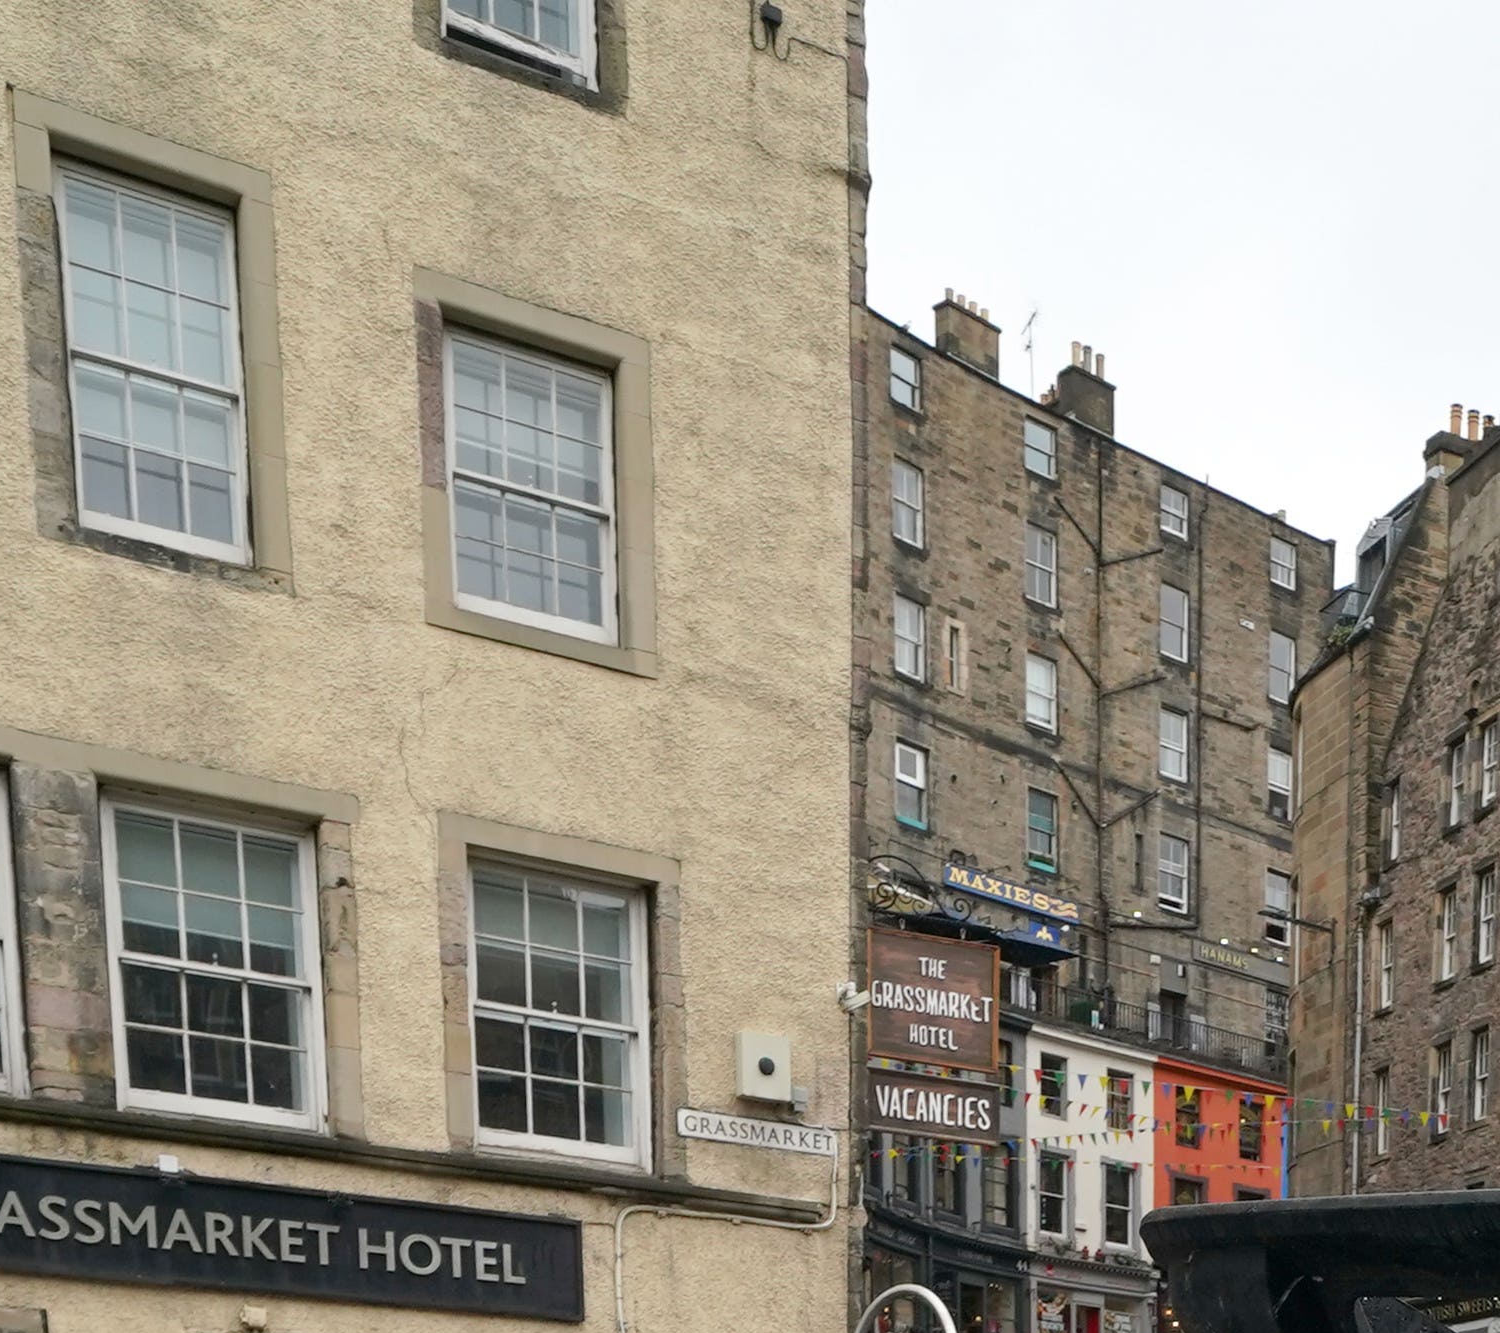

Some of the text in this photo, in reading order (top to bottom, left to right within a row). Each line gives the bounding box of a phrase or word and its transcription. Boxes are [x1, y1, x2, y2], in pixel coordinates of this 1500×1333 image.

[918, 957, 947, 979] THE
[871, 980, 993, 1023] GRASSMARKET
[909, 1024, 958, 1050] HOTEL
[874, 1085, 991, 1130] VACANCIES
[684, 1115, 833, 1151] GRASSMARKET
[359, 1228, 527, 1285] HOTEL
